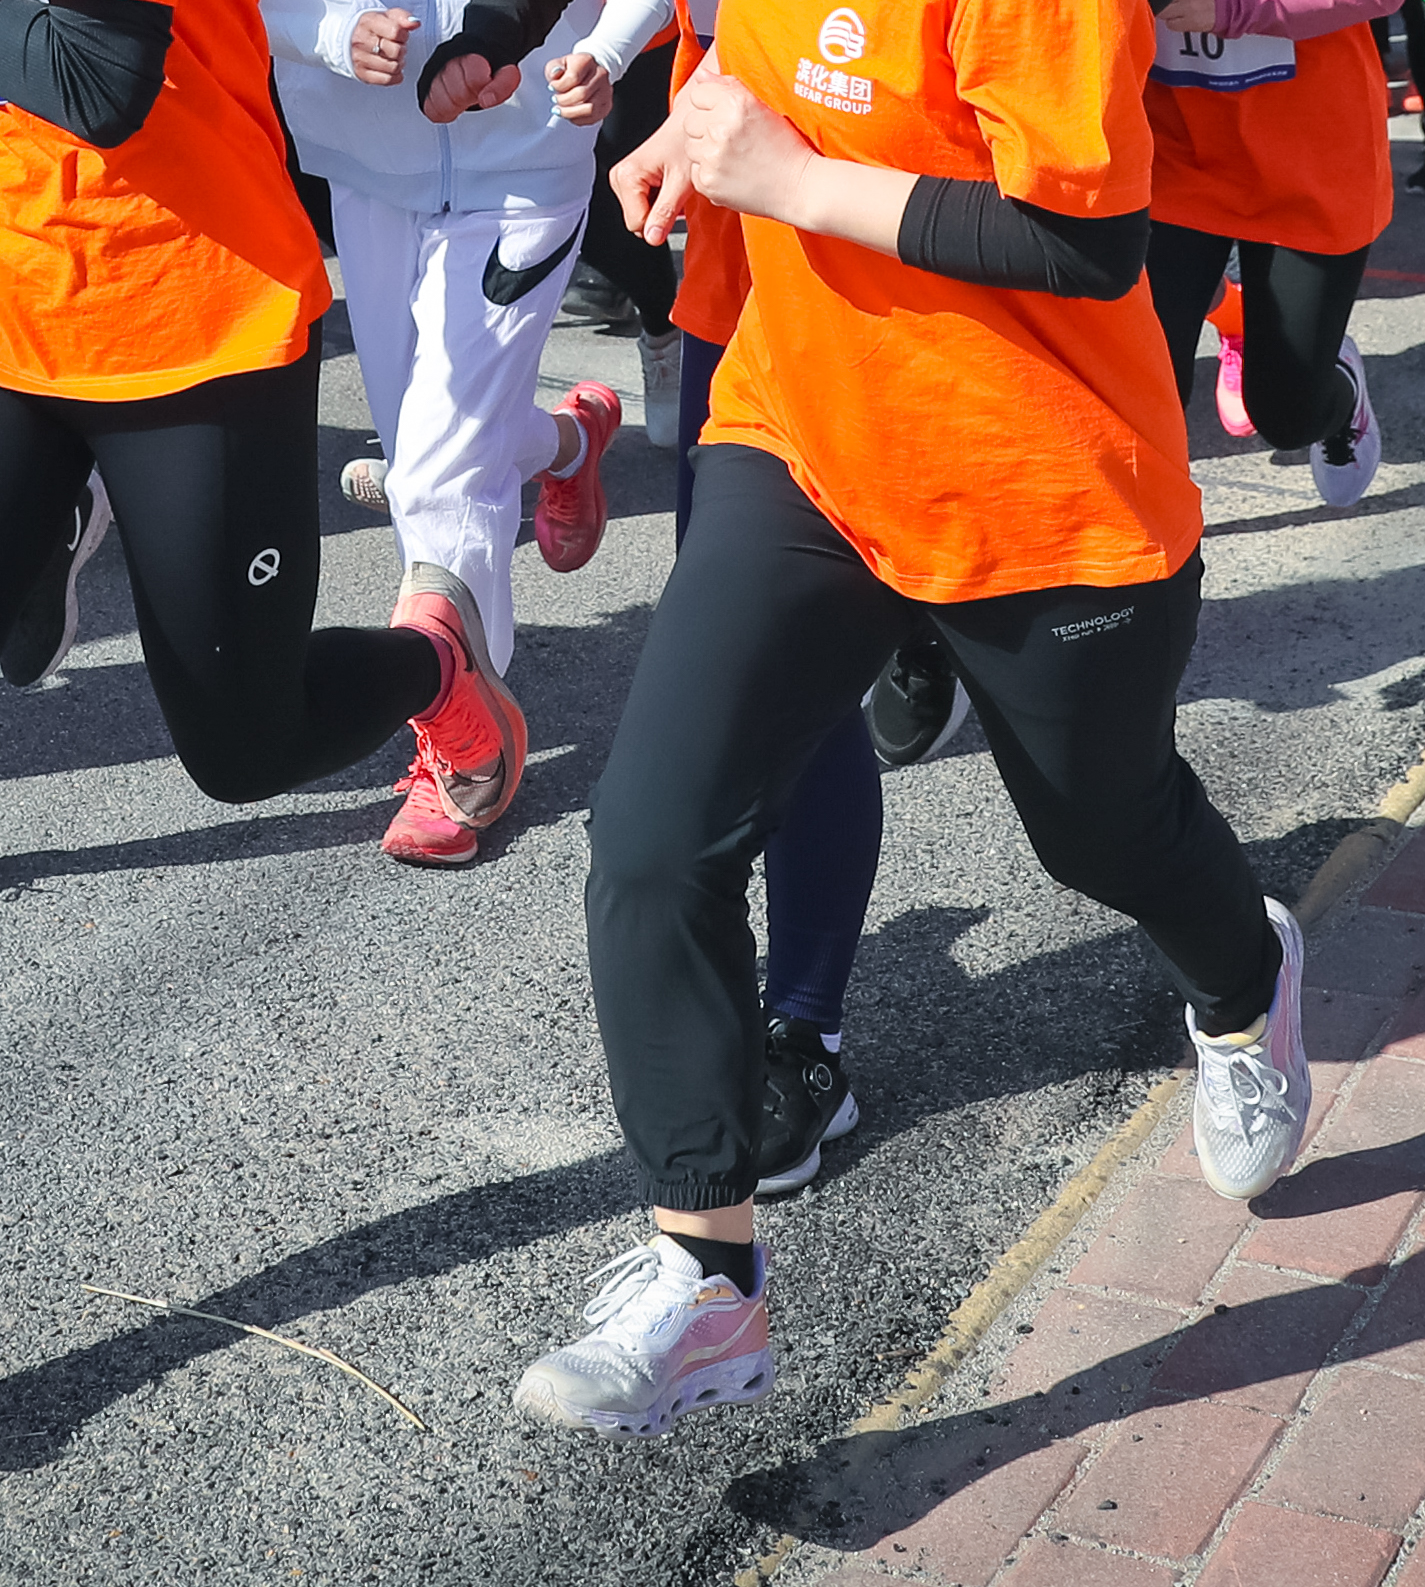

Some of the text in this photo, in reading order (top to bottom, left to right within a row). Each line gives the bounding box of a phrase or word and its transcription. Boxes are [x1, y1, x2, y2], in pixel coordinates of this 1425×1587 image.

[1179, 31, 1224, 60] 10
[795, 57, 873, 103] 滨化集团
[794, 82, 873, 115] BEFAR GROUP
[1051, 606, 1135, 637] TECHNOLOGY
